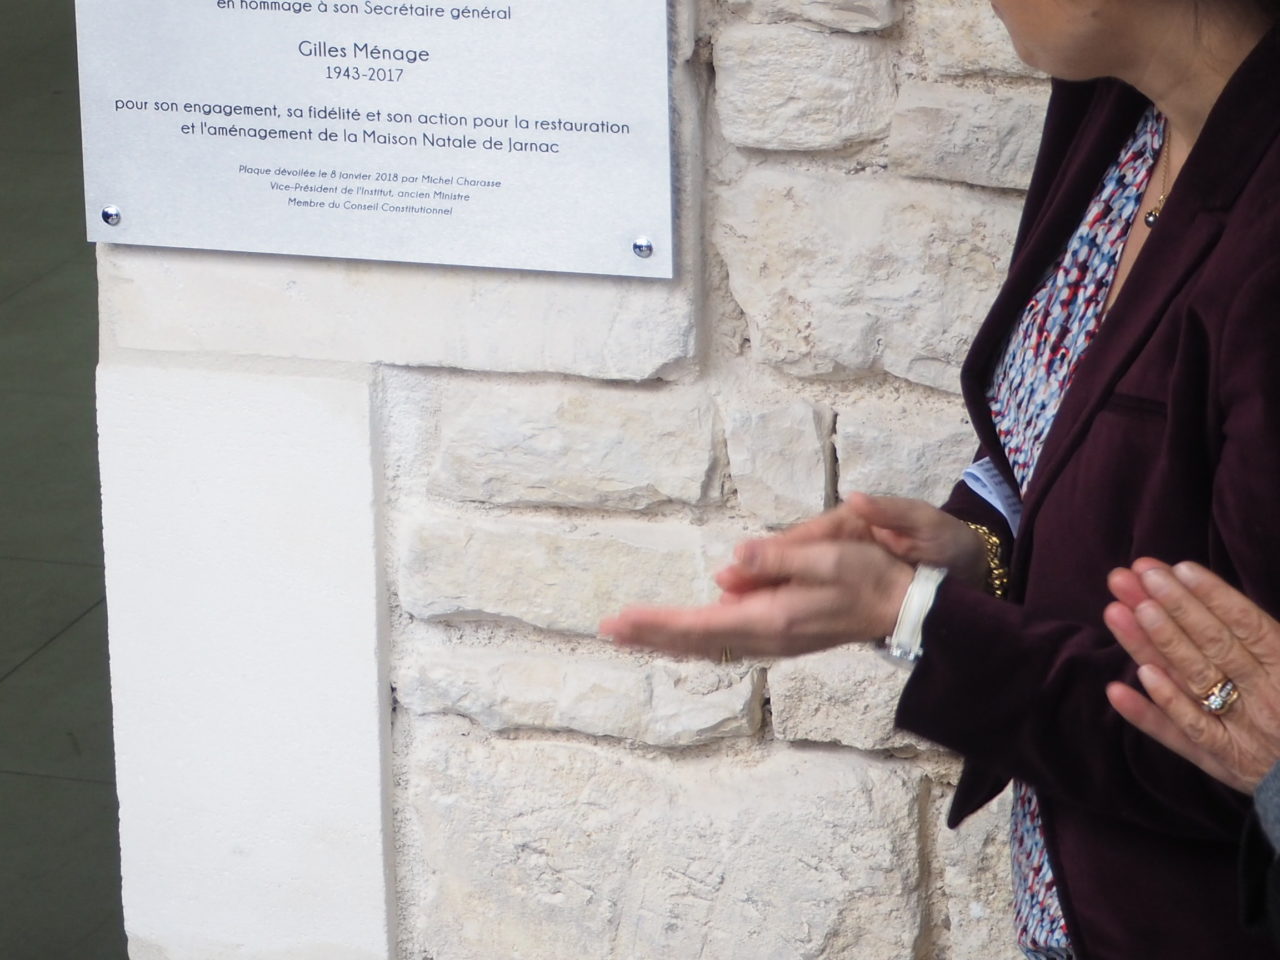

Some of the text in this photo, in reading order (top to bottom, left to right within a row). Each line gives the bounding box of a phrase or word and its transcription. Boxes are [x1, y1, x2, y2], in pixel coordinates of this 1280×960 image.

[317, 0, 328, 14] à
[332, 3, 359, 15] son
[363, 0, 446, 18] Secrétaire
[449, 5, 512, 21] général
[297, 39, 430, 65] Gilles Ménage
[325, 65, 404, 83] 1943-2017
[114, 98, 630, 135] pour son engagement, sa fidélité et son action pour la restauration
[180, 120, 560, 154] et l'aménagement de la Maison Natale de Jarnac
[238, 164, 272, 176] Plaque
[273, 167, 317, 178] dévoilée
[317, 168, 328, 179] le
[329, 169, 337, 179] 8
[374, 171, 399, 183] 2018
[400, 175, 419, 184] par
[421, 174, 454, 186] Michel
[456, 176, 502, 188] Charasse
[269, 181, 338, 194] Vice-Président
[340, 185, 354, 195] de
[397, 190, 431, 199] ancien
[432, 190, 471, 202] Ministre
[287, 196, 453, 216] Membre du Conseil Constitutionnel
